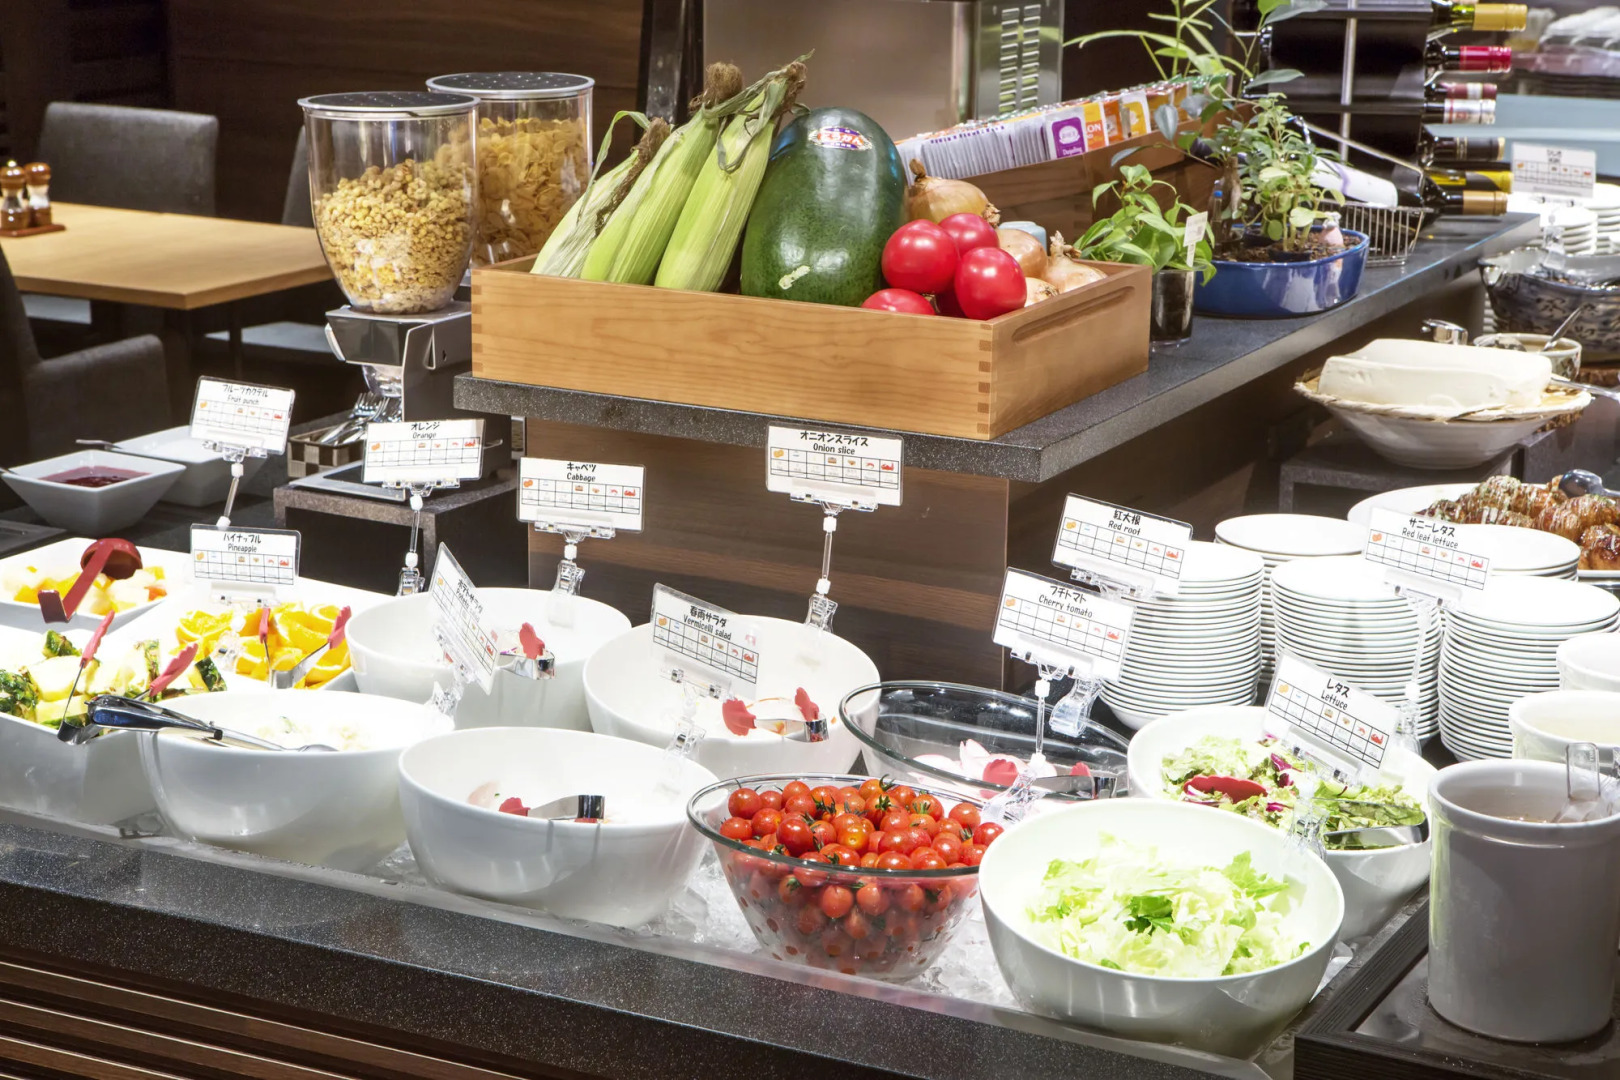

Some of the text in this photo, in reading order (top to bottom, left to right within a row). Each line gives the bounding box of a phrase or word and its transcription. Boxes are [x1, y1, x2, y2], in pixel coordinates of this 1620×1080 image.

[223, 384, 269, 398] フルーツカクテル
[411, 421, 441, 431] オレンジ
[412, 431, 437, 440] Orange
[800, 430, 869, 447] オニオンスライス
[813, 443, 856, 455] Onion slice
[566, 461, 597, 473] キャベツ
[566, 472, 596, 483] Cabbage
[1108, 520, 1123, 531] Red
[1113, 508, 1141, 526] 紅大根
[1409, 517, 1456, 538] サニーレタス
[1402, 527, 1459, 549] Red leaf lettuce
[227, 543, 258, 553] Pineapple
[1038, 594, 1093, 618] Cherry tomato
[690, 605, 728, 628] 春雨サラダ
[683, 614, 732, 641] Vermicelli salad
[1326, 678, 1350, 698] レタス
[1320, 690, 1348, 711] Lettuce
